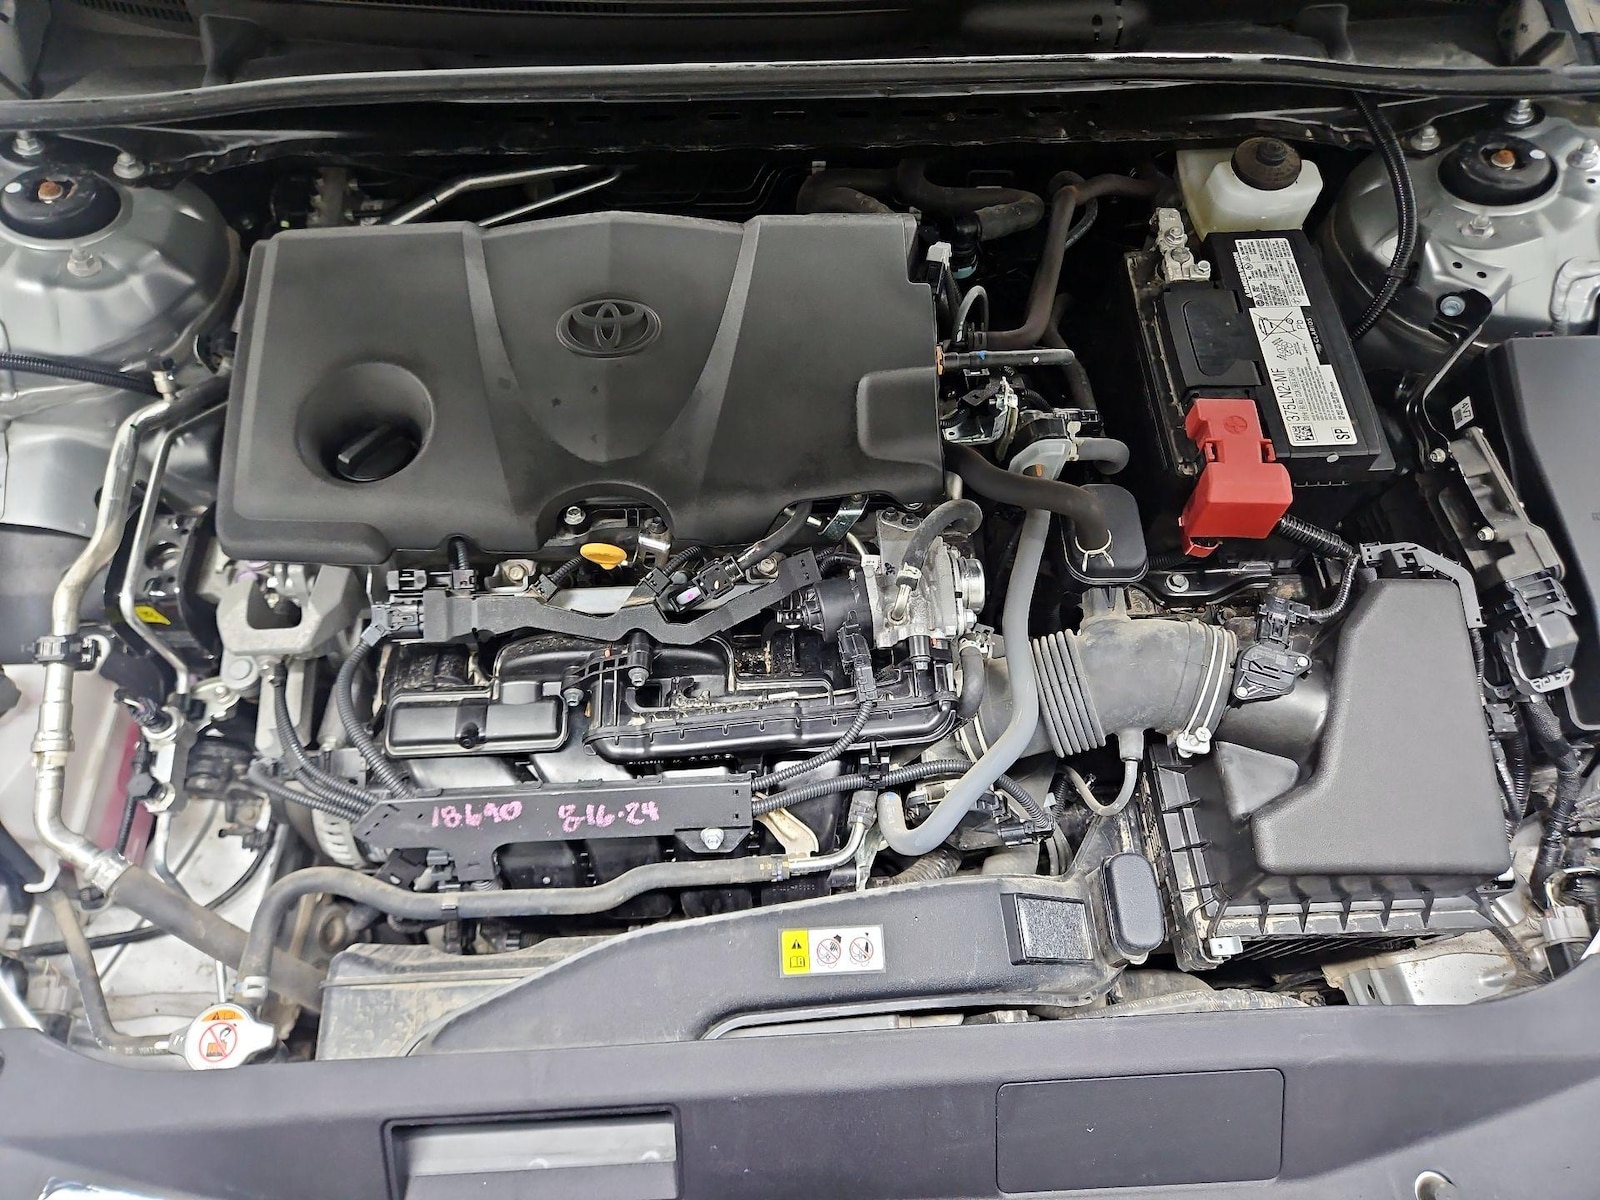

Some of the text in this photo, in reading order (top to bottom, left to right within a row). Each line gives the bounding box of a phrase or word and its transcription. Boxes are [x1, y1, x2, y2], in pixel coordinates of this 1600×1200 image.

[1296, 319, 1306, 330] Pb
[1306, 317, 1320, 343] CLARIOS
[1271, 368, 1300, 421] 375LN2-MF
[1334, 428, 1350, 440] SP
